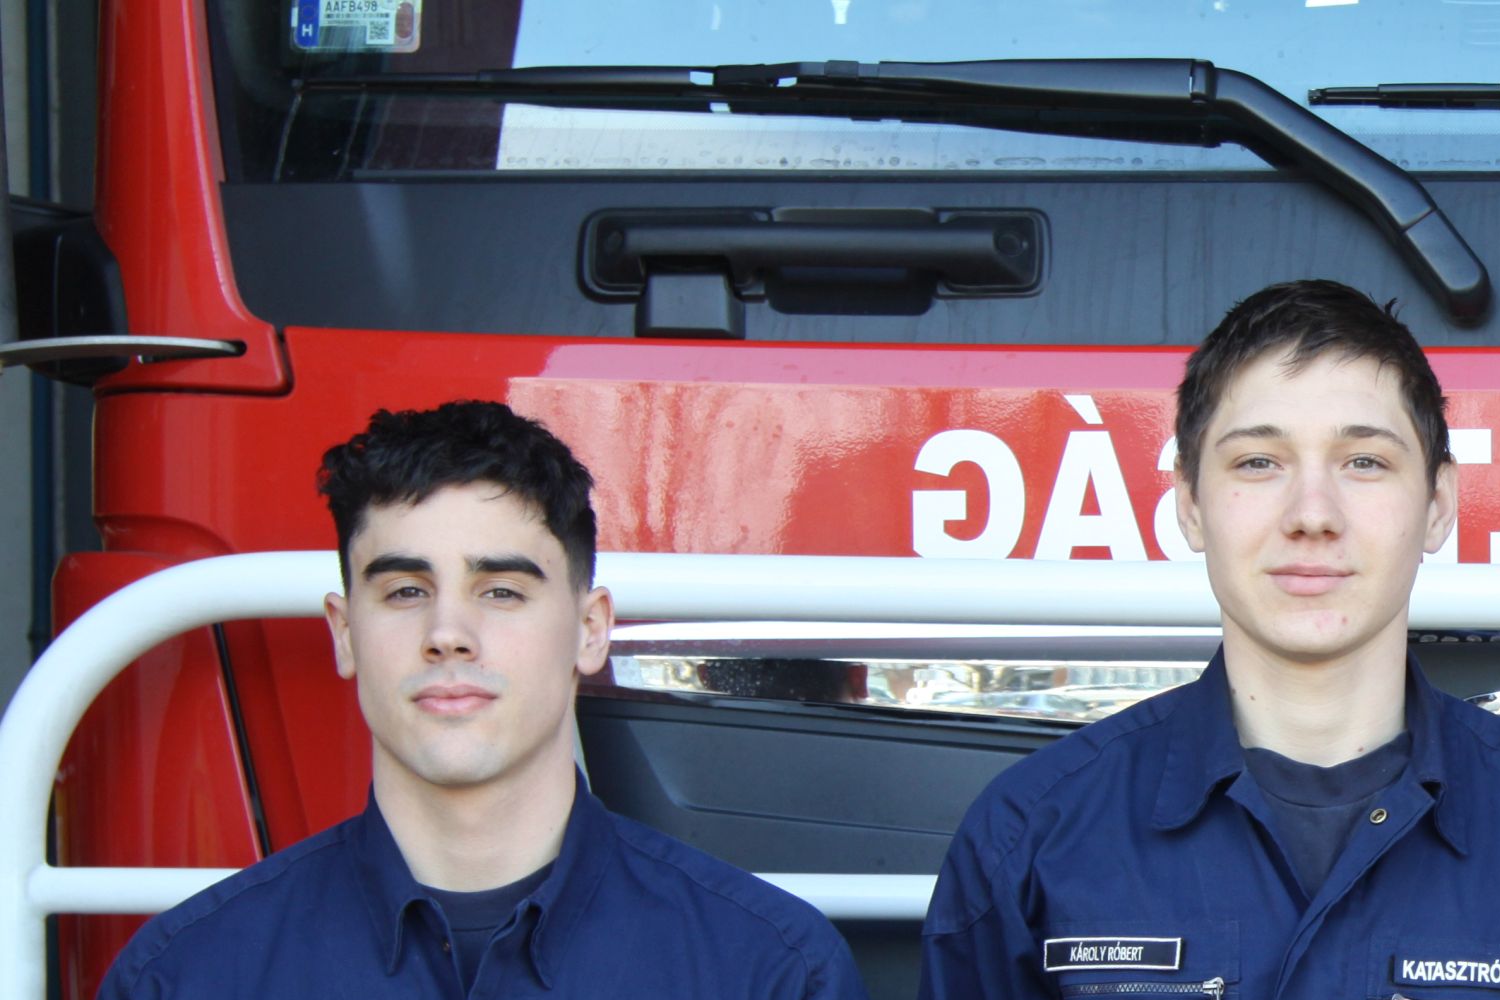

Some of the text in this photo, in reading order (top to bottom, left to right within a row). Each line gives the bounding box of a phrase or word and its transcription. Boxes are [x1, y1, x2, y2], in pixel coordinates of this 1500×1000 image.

[302, 24, 313, 37] H
[1069, 941, 1144, 962] KÁROLY RÓBERT
